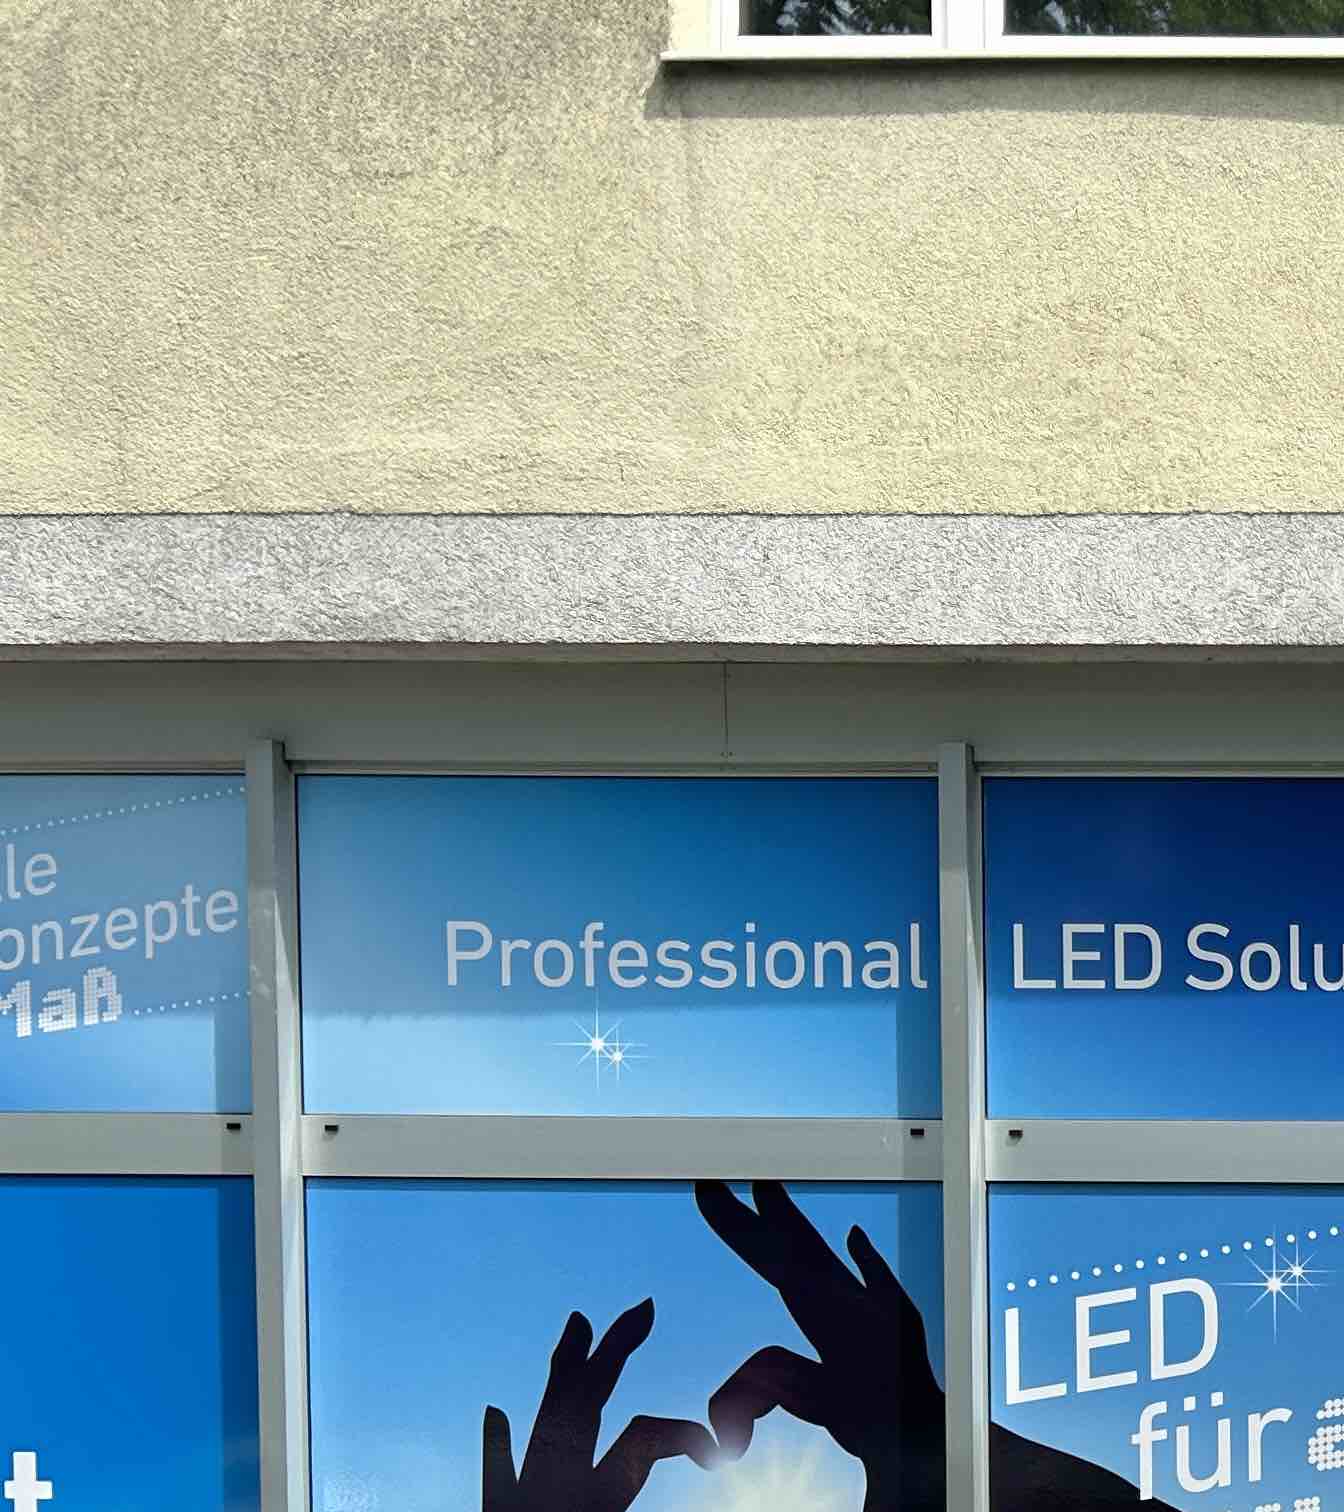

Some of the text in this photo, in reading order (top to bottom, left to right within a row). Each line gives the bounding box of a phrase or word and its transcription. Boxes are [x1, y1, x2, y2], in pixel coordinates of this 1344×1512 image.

[446, 920, 928, 989] Professional
[1012, 923, 1162, 991] LED
[1004, 1277, 1220, 1406] LED
[1130, 1391, 1294, 1500] für
